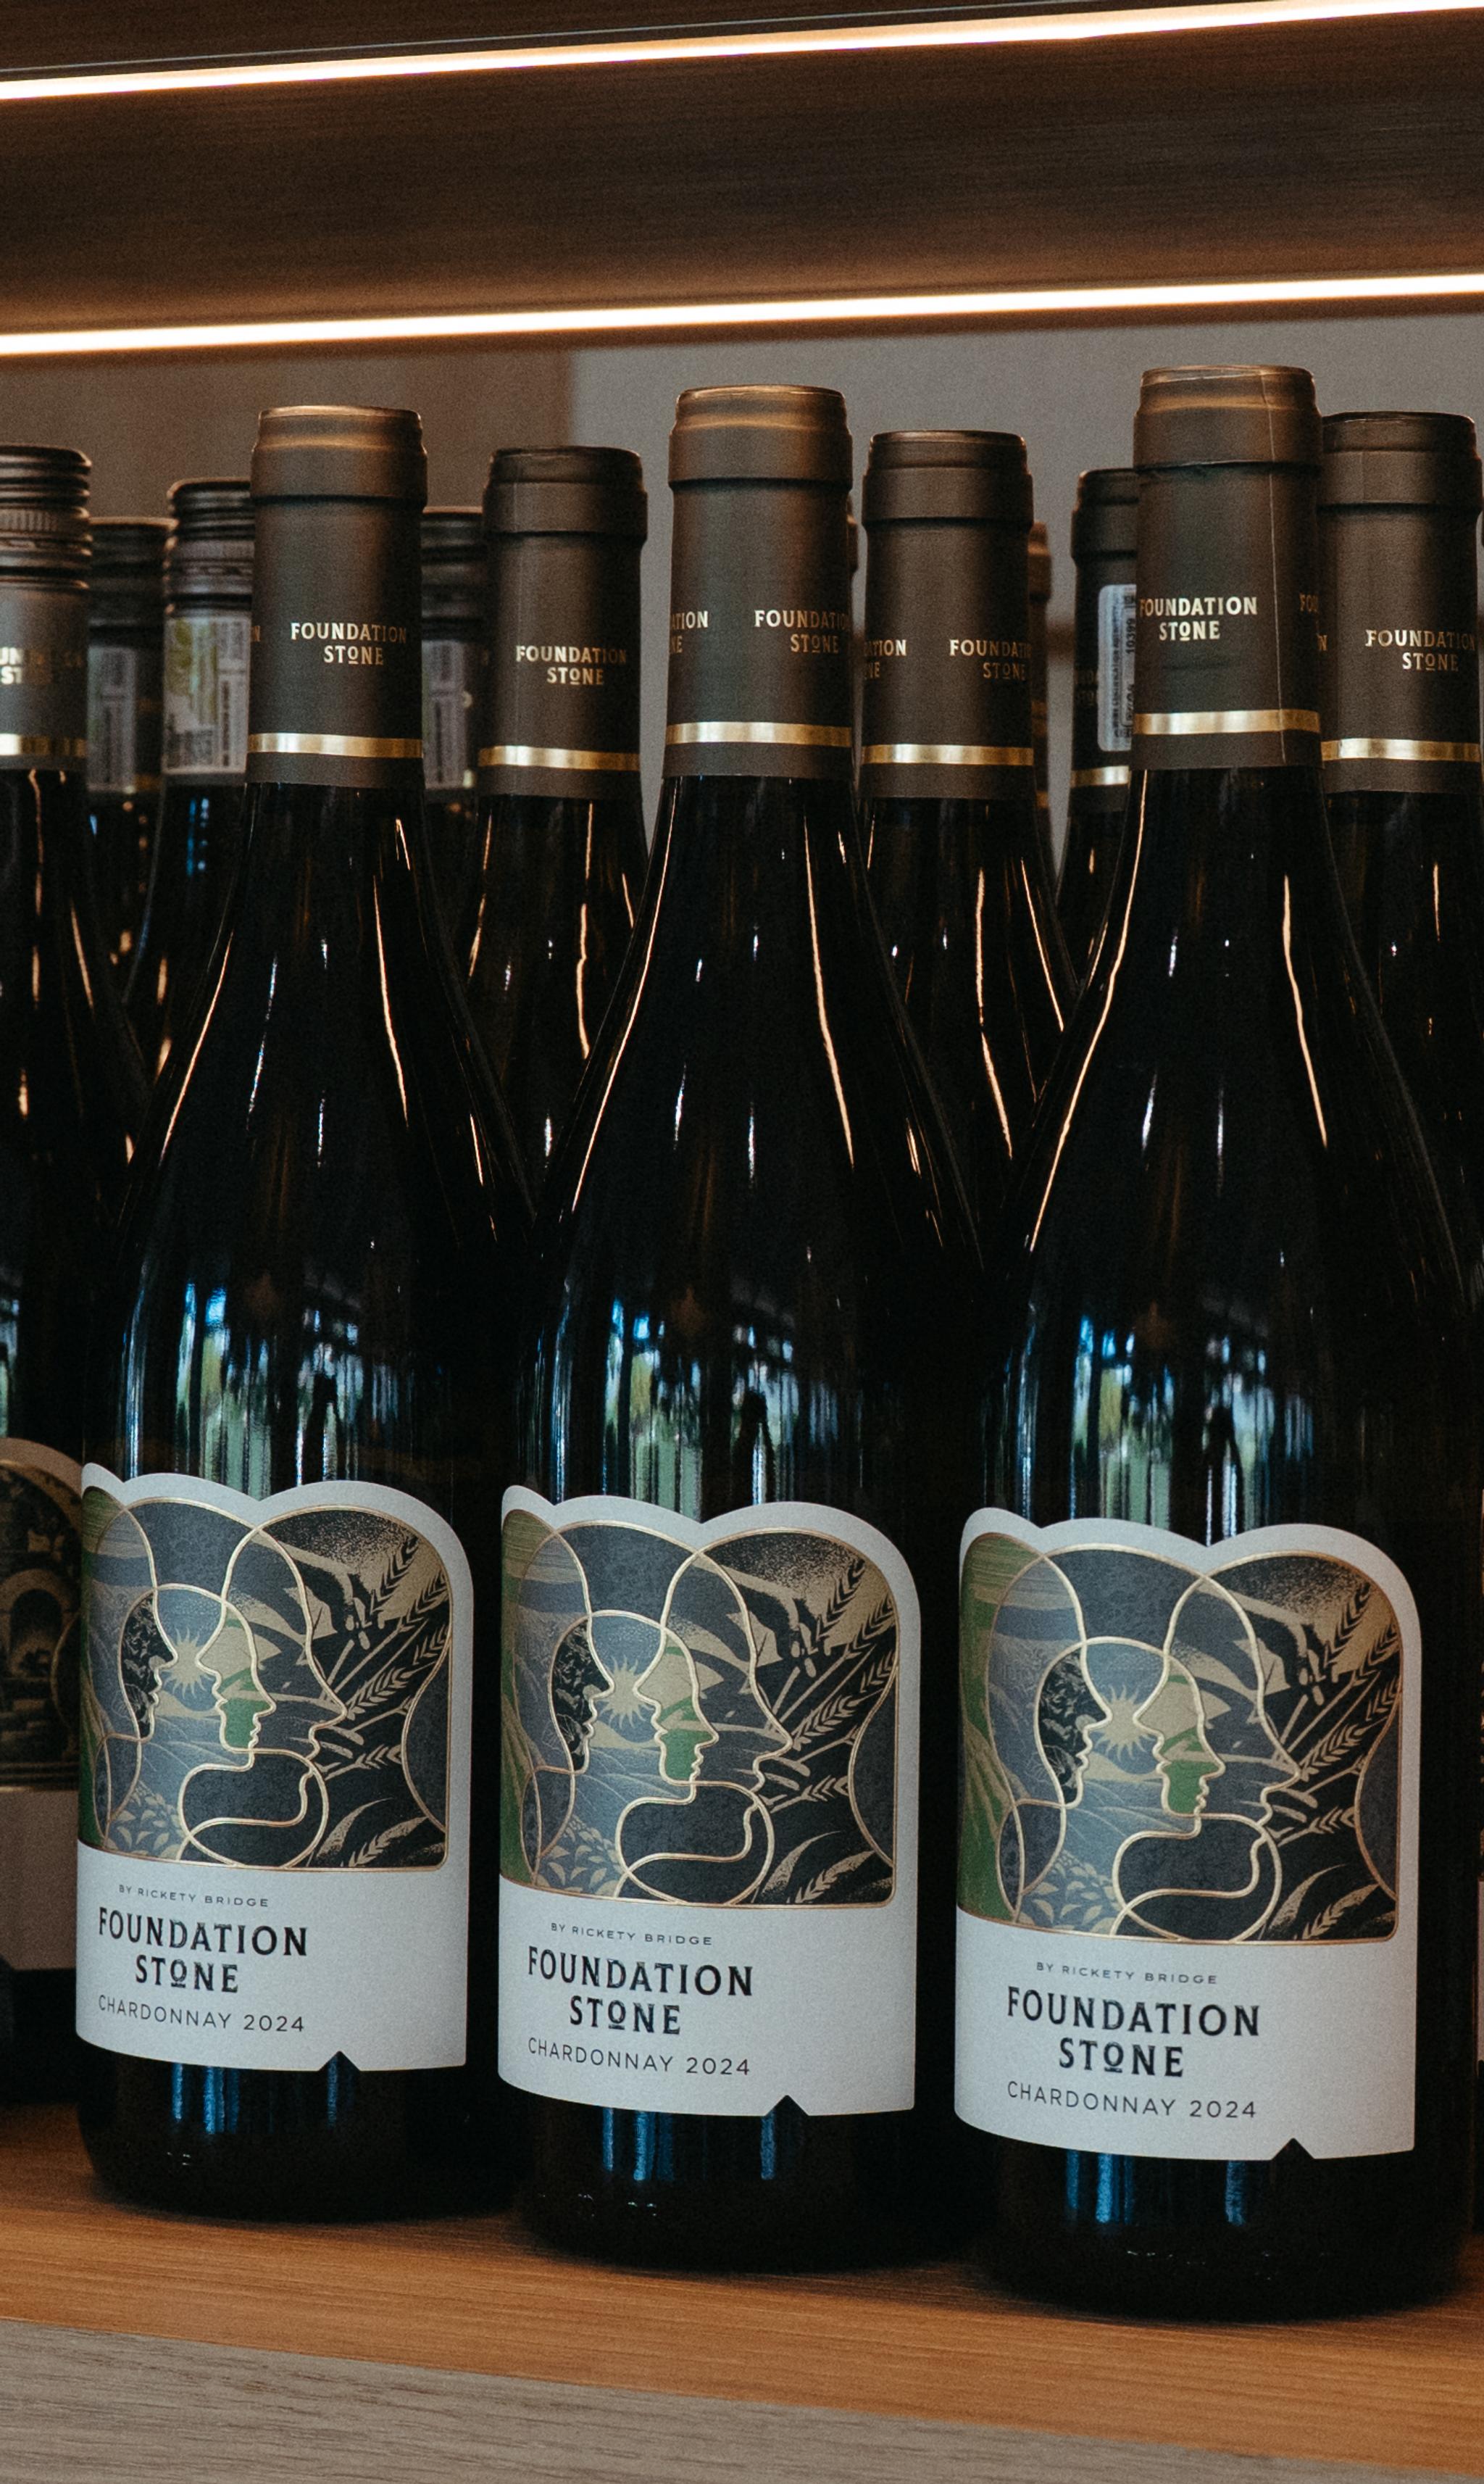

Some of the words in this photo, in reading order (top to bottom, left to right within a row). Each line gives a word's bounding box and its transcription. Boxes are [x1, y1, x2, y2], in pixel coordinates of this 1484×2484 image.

[1140, 597, 1258, 616] FOUNDATION
[291, 622, 407, 643] FOUNDATION
[1159, 620, 1220, 641] STONE
[1365, 629, 1476, 651] FOUNDATION
[323, 644, 383, 665] STONE
[791, 634, 839, 653] STONE
[515, 645, 627, 665] FOUNDATION
[1402, 652, 1459, 672] STONE
[546, 667, 604, 685] STONE
[119, 1885, 132, 1894] BY
[138, 1888, 196, 1902] RICKETY
[204, 1895, 269, 1907] BRIDGE
[99, 1906, 307, 1956] FOUNDATION
[551, 1923, 565, 1932] BY
[572, 1926, 636, 1941] RICKETY
[645, 1934, 712, 1945] BRIDGE
[136, 1955, 238, 1993] STONE
[528, 1945, 753, 1996] FOUNDATION
[1036, 1962, 1054, 1972] BY
[1062, 1966, 1135, 1980] RICKETY
[1145, 1973, 1217, 1985] BRIDGE
[99, 1995, 232, 2029] CHARDONNAY
[243, 2014, 304, 2032] 2024
[570, 1995, 680, 2035] STONE
[1007, 1986, 1260, 2036] FOUNDATION
[528, 2038, 673, 2072] CHARDONNAY
[685, 2057, 749, 2075] 2024
[1059, 2037, 1183, 2077] STONE
[1007, 2080, 1175, 2116] CHARDONNAY
[1190, 2100, 1256, 2118] 2024
